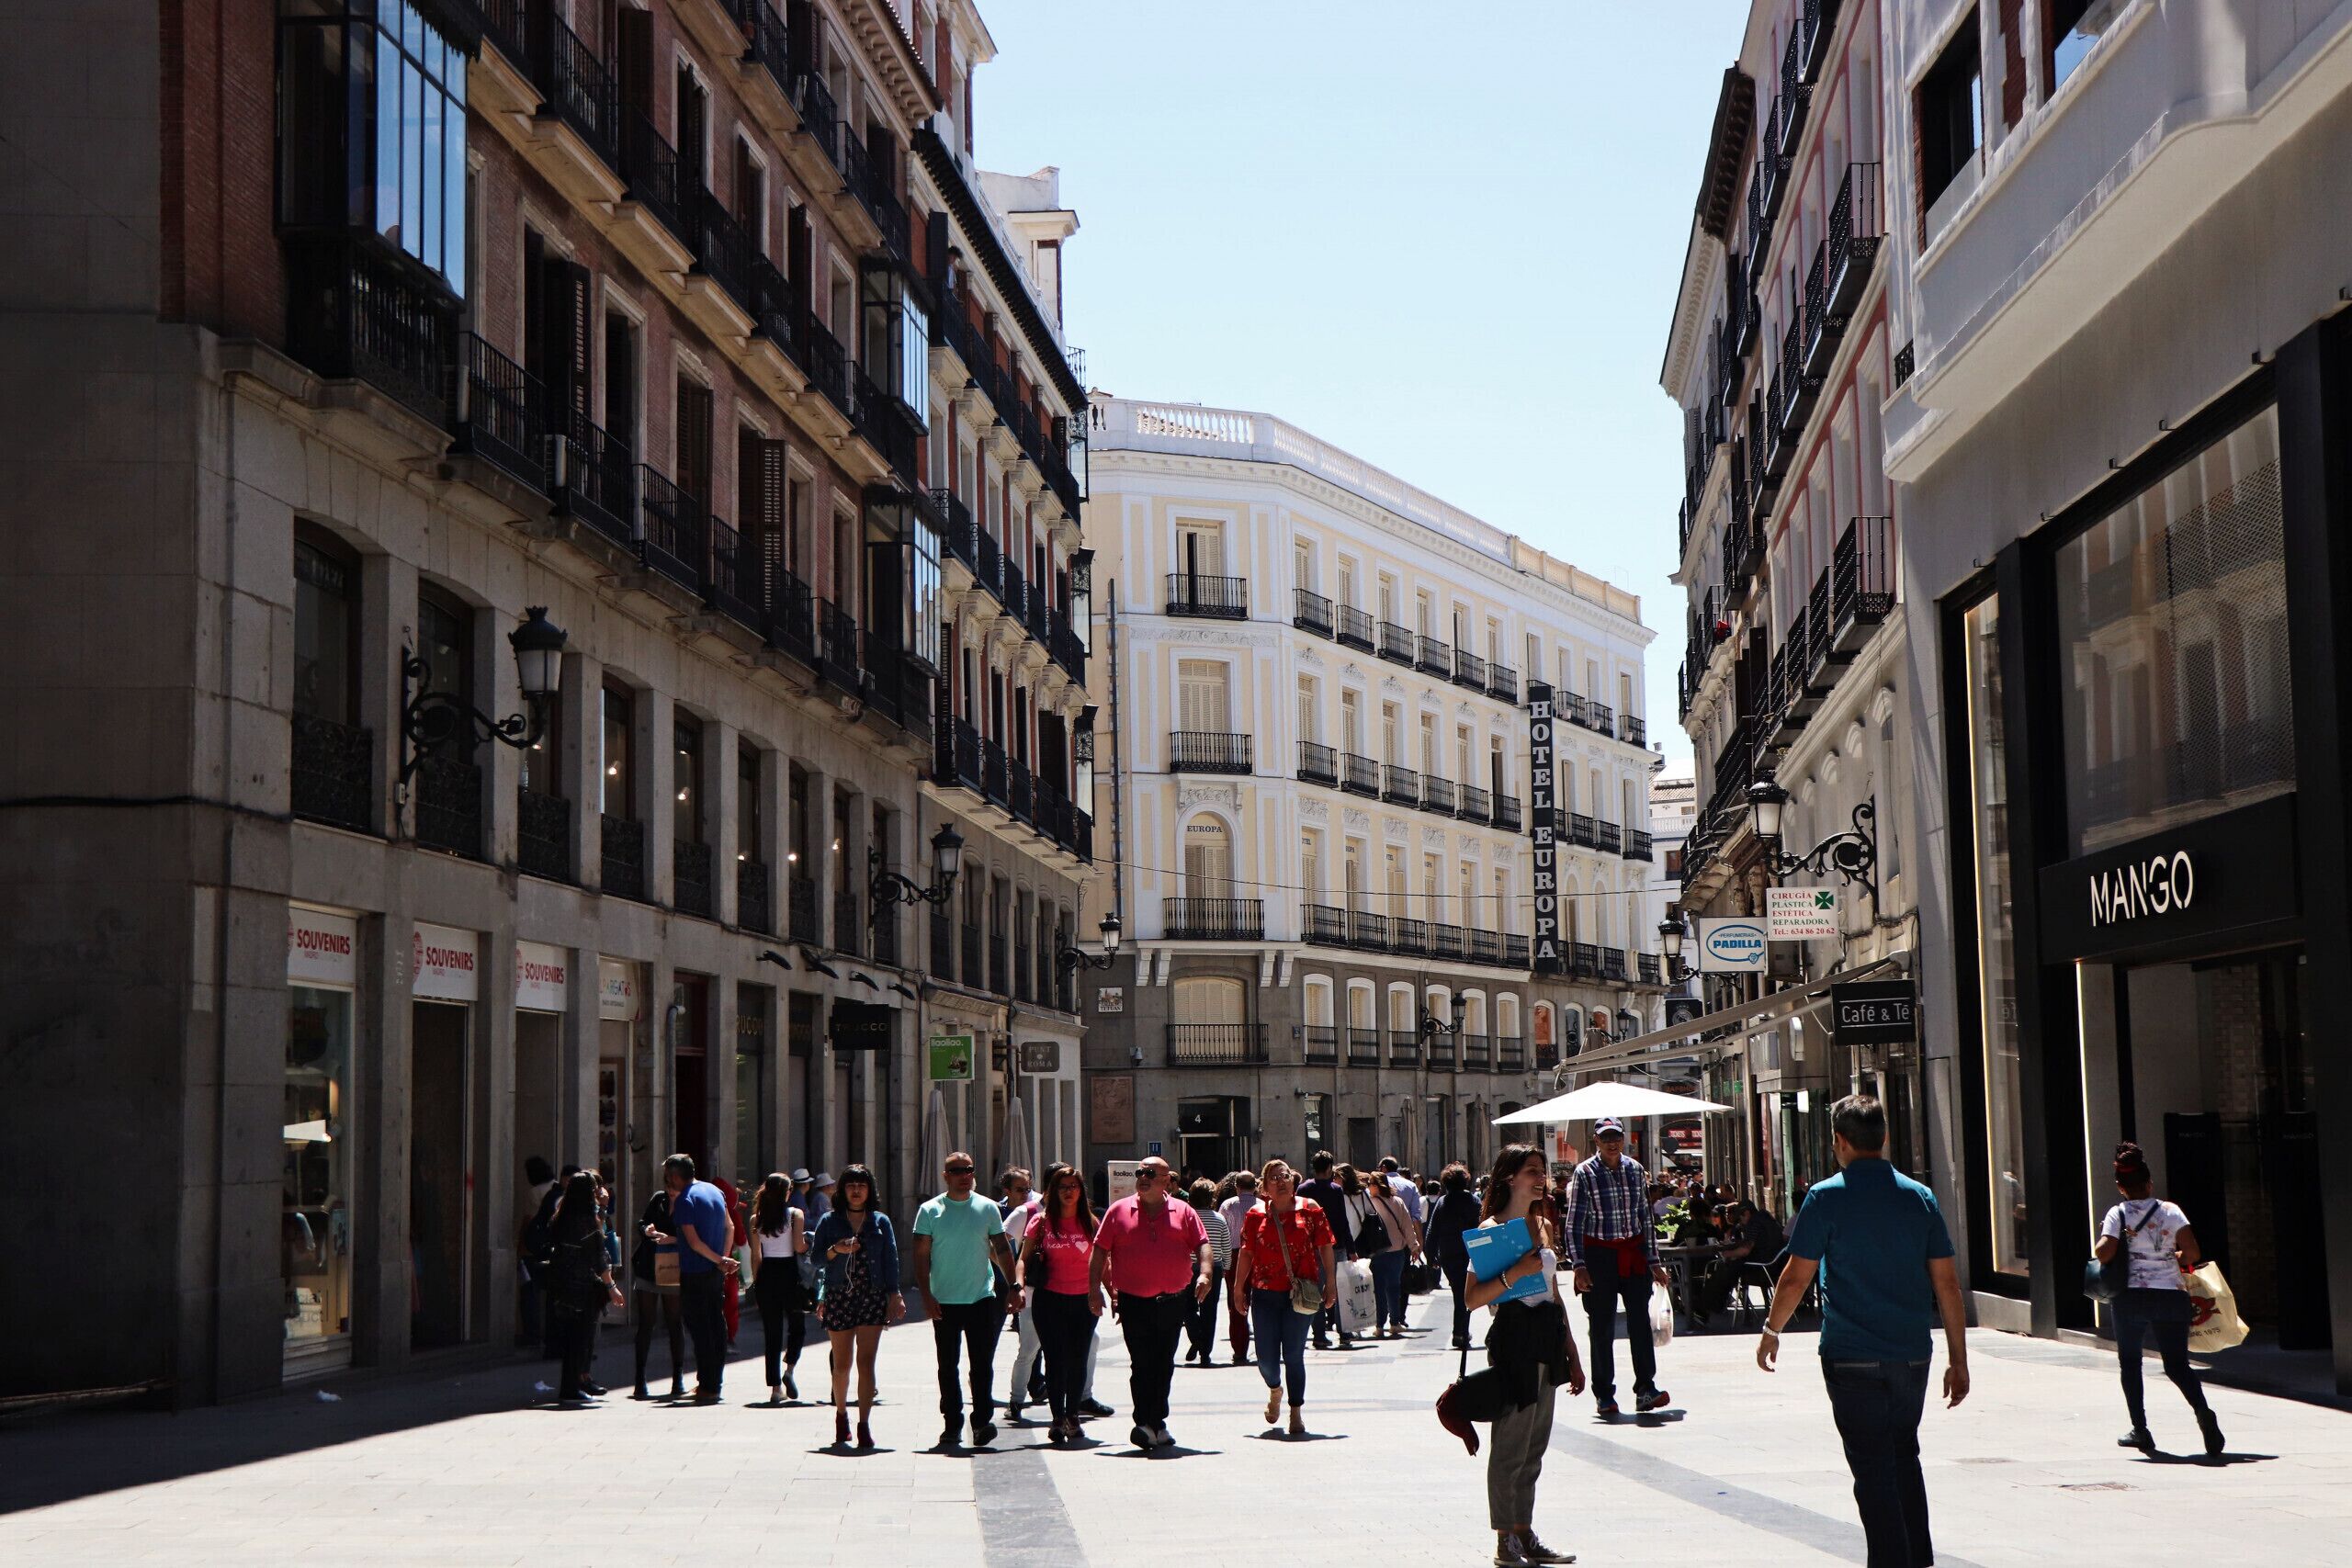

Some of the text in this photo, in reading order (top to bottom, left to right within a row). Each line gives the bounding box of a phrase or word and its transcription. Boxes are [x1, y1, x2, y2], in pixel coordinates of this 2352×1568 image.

[1531, 701, 1556, 957] HOTEL EUROPA
[1771, 891, 1812, 899] CIRUGÍA
[2090, 851, 2194, 927] MANGO
[1772, 908, 1813, 917] ESTÉTICA
[297, 929, 351, 956] SOUVENIRS
[1713, 940, 1761, 949] PADILLA
[426, 946, 474, 972] SOUVENIRS
[526, 962, 564, 984] SOUVENIRS
[1882, 1009, 1891, 1021] &
[1194, 1114, 1202, 1123] 4
